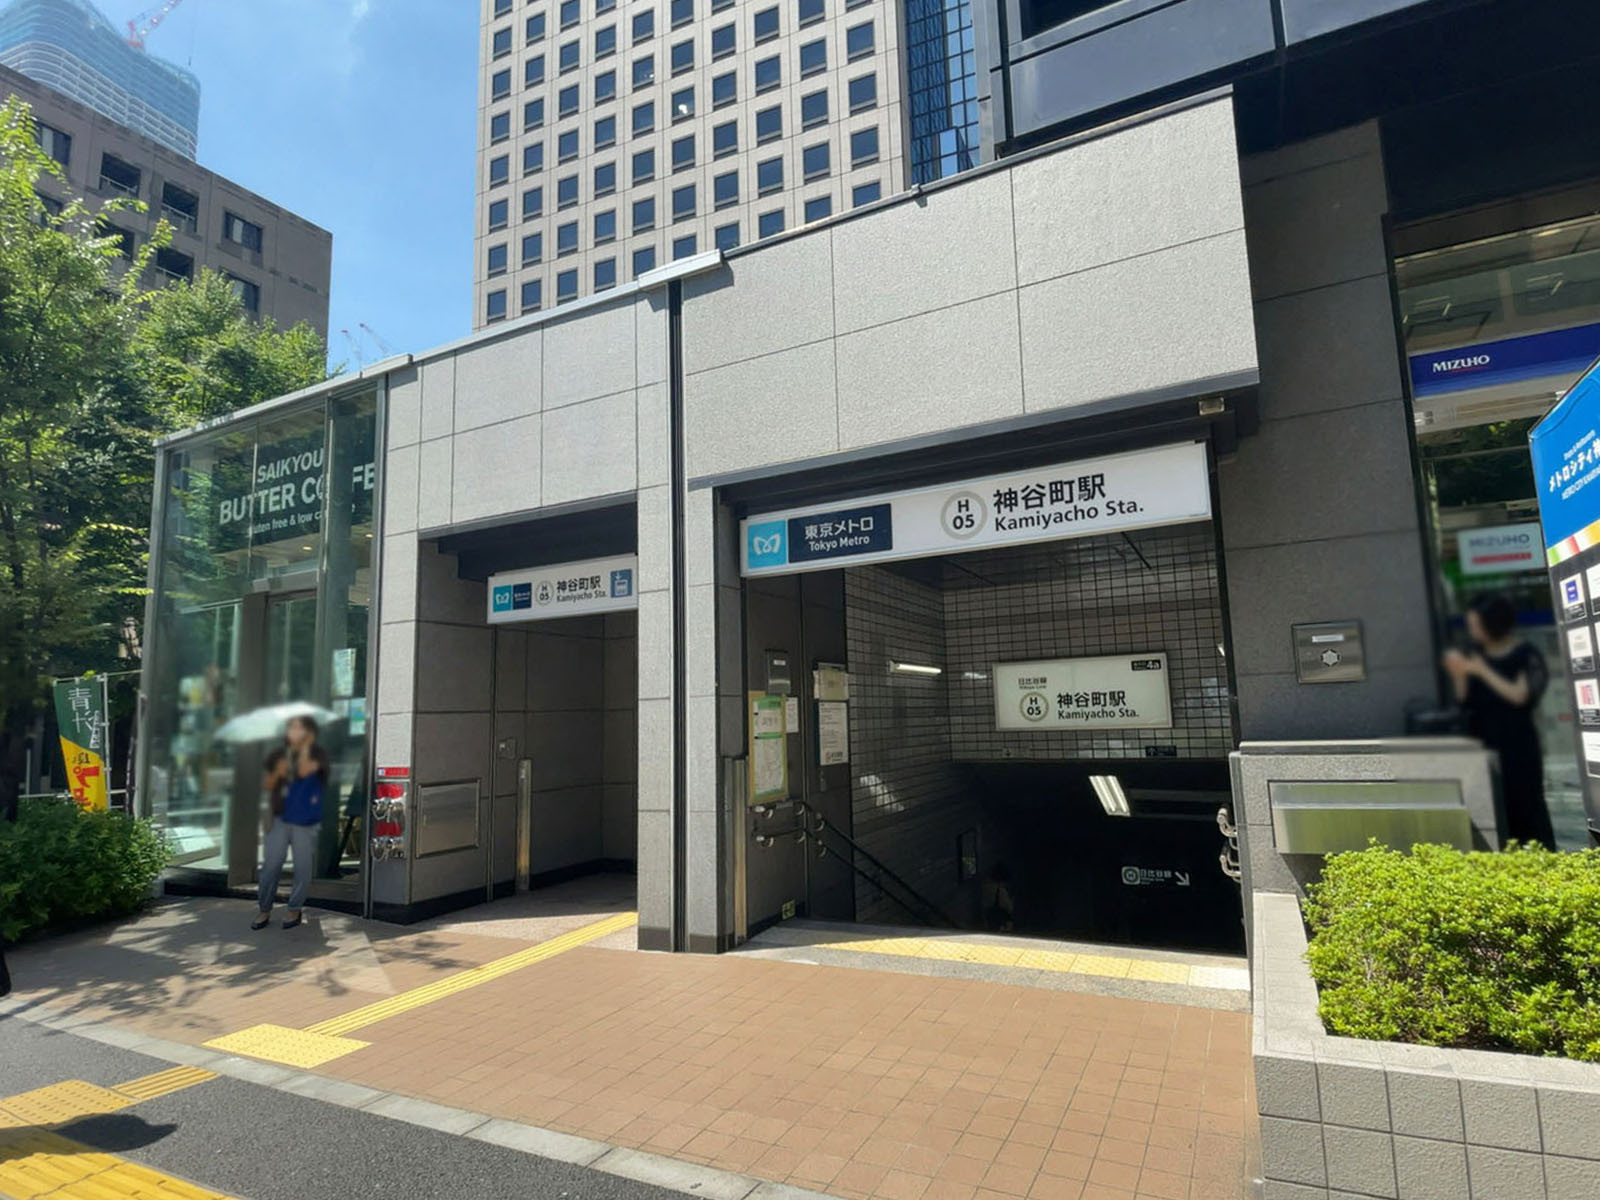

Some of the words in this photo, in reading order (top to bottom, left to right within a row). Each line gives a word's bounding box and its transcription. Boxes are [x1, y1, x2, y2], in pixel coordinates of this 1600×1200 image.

[1432, 355, 1490, 372] MIZUHO
[257, 449, 323, 483] SAIKYOU
[993, 473, 1107, 515] 神谷町駅
[219, 483, 295, 525] BUTTER
[957, 499, 970, 514] H
[272, 515, 288, 531] free
[297, 511, 313, 525] low
[952, 513, 976, 530] 05
[994, 505, 1099, 533] Kamiyacho
[1105, 498, 1144, 517] Sta.
[804, 516, 875, 540] 東京メトロ
[808, 538, 838, 552] Tokyo
[839, 533, 870, 548] Metro
[1469, 533, 1530, 547] MIZUHO
[541, 584, 548, 592] H
[556, 575, 601, 593] 神谷町駅
[539, 592, 550, 602] 05
[556, 591, 593, 604] Kamiyacho
[593, 590, 607, 600] Sta.
[1029, 697, 1038, 706] H
[1057, 691, 1127, 709] 神谷町駅
[1027, 706, 1042, 716] 05
[1058, 708, 1116, 722] Kamiyacho
[1119, 708, 1140, 718] Sta.
